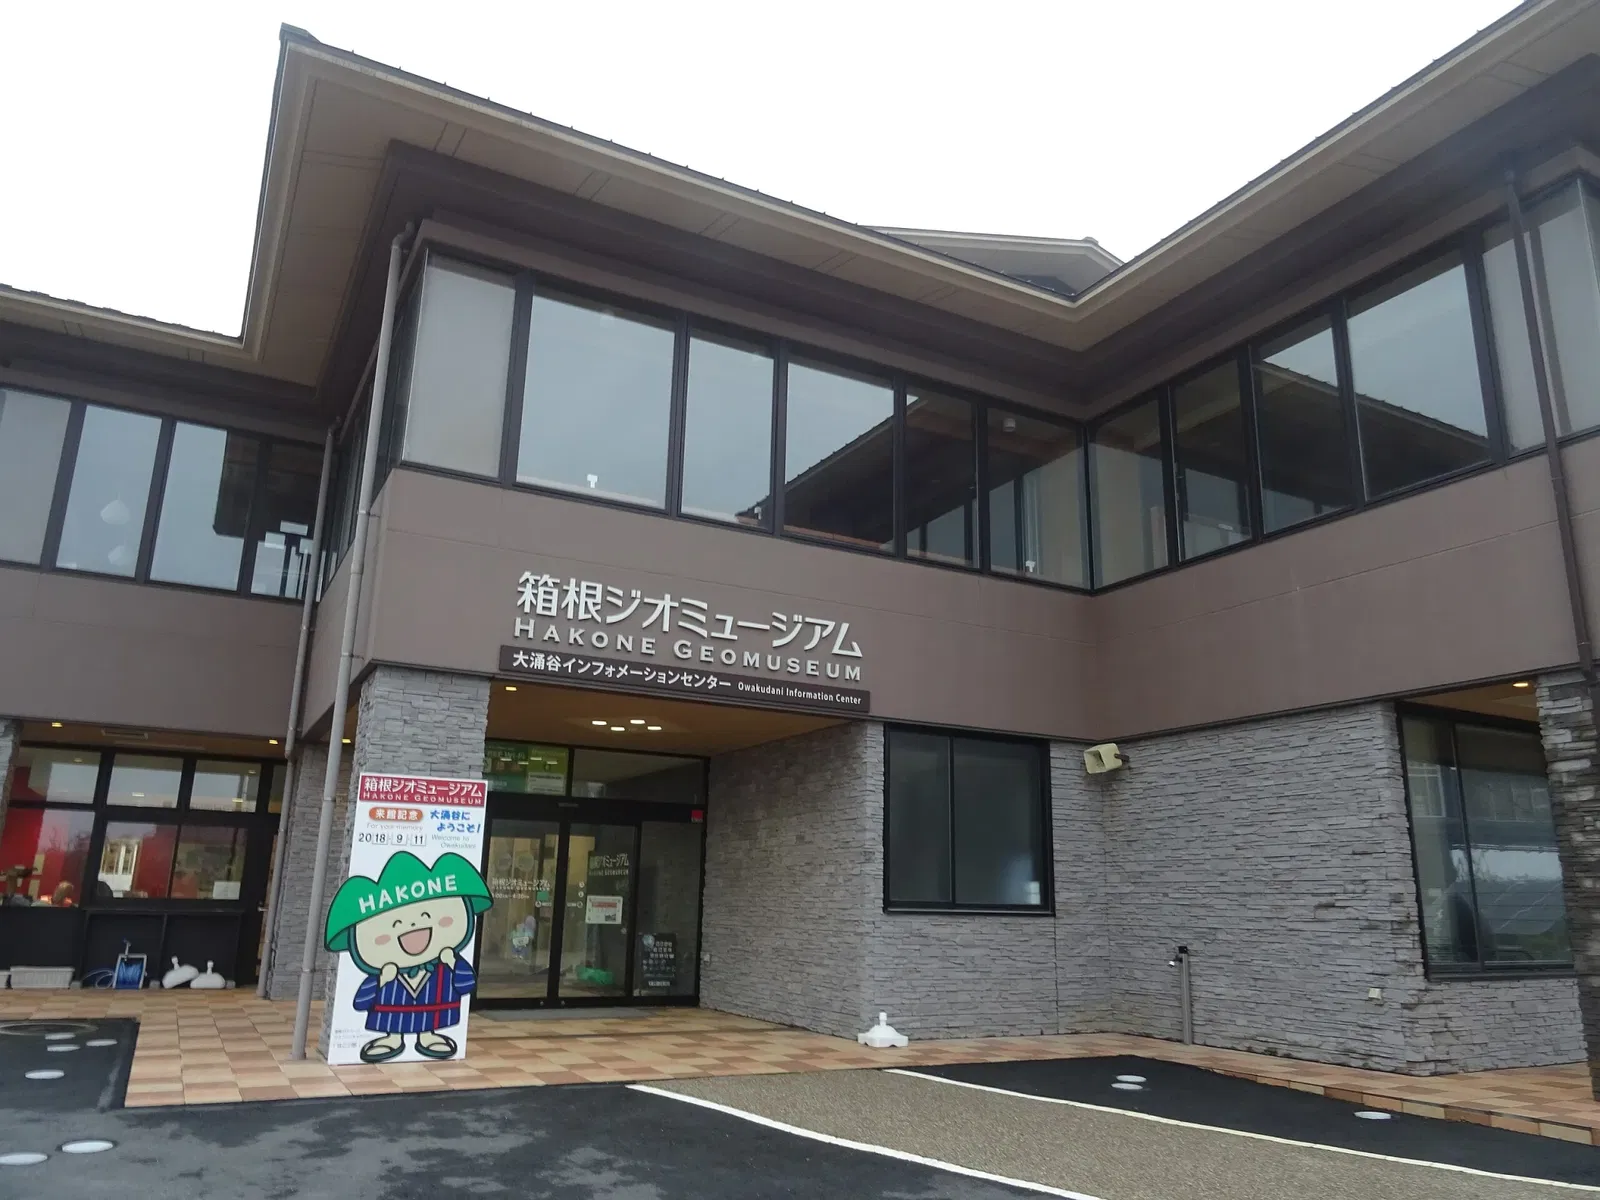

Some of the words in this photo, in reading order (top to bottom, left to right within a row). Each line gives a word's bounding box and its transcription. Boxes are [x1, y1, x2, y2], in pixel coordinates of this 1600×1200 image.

[517, 571, 863, 658] 箱根ジオミュージアム
[513, 617, 656, 655] HAKONE
[673, 639, 862, 681] GEOMUSEUM
[512, 651, 732, 689] 大涌谷インフォメーションセンター
[738, 681, 784, 696] Owakudani
[786, 688, 834, 702] Information
[835, 693, 862, 705] Center
[363, 792, 409, 801] HAKONE
[414, 794, 482, 805] GEOMUSEUM
[364, 777, 482, 797] 箱根ジオミュージアム
[430, 810, 471, 821] 大涌谷に
[358, 874, 458, 914] HAKONE
